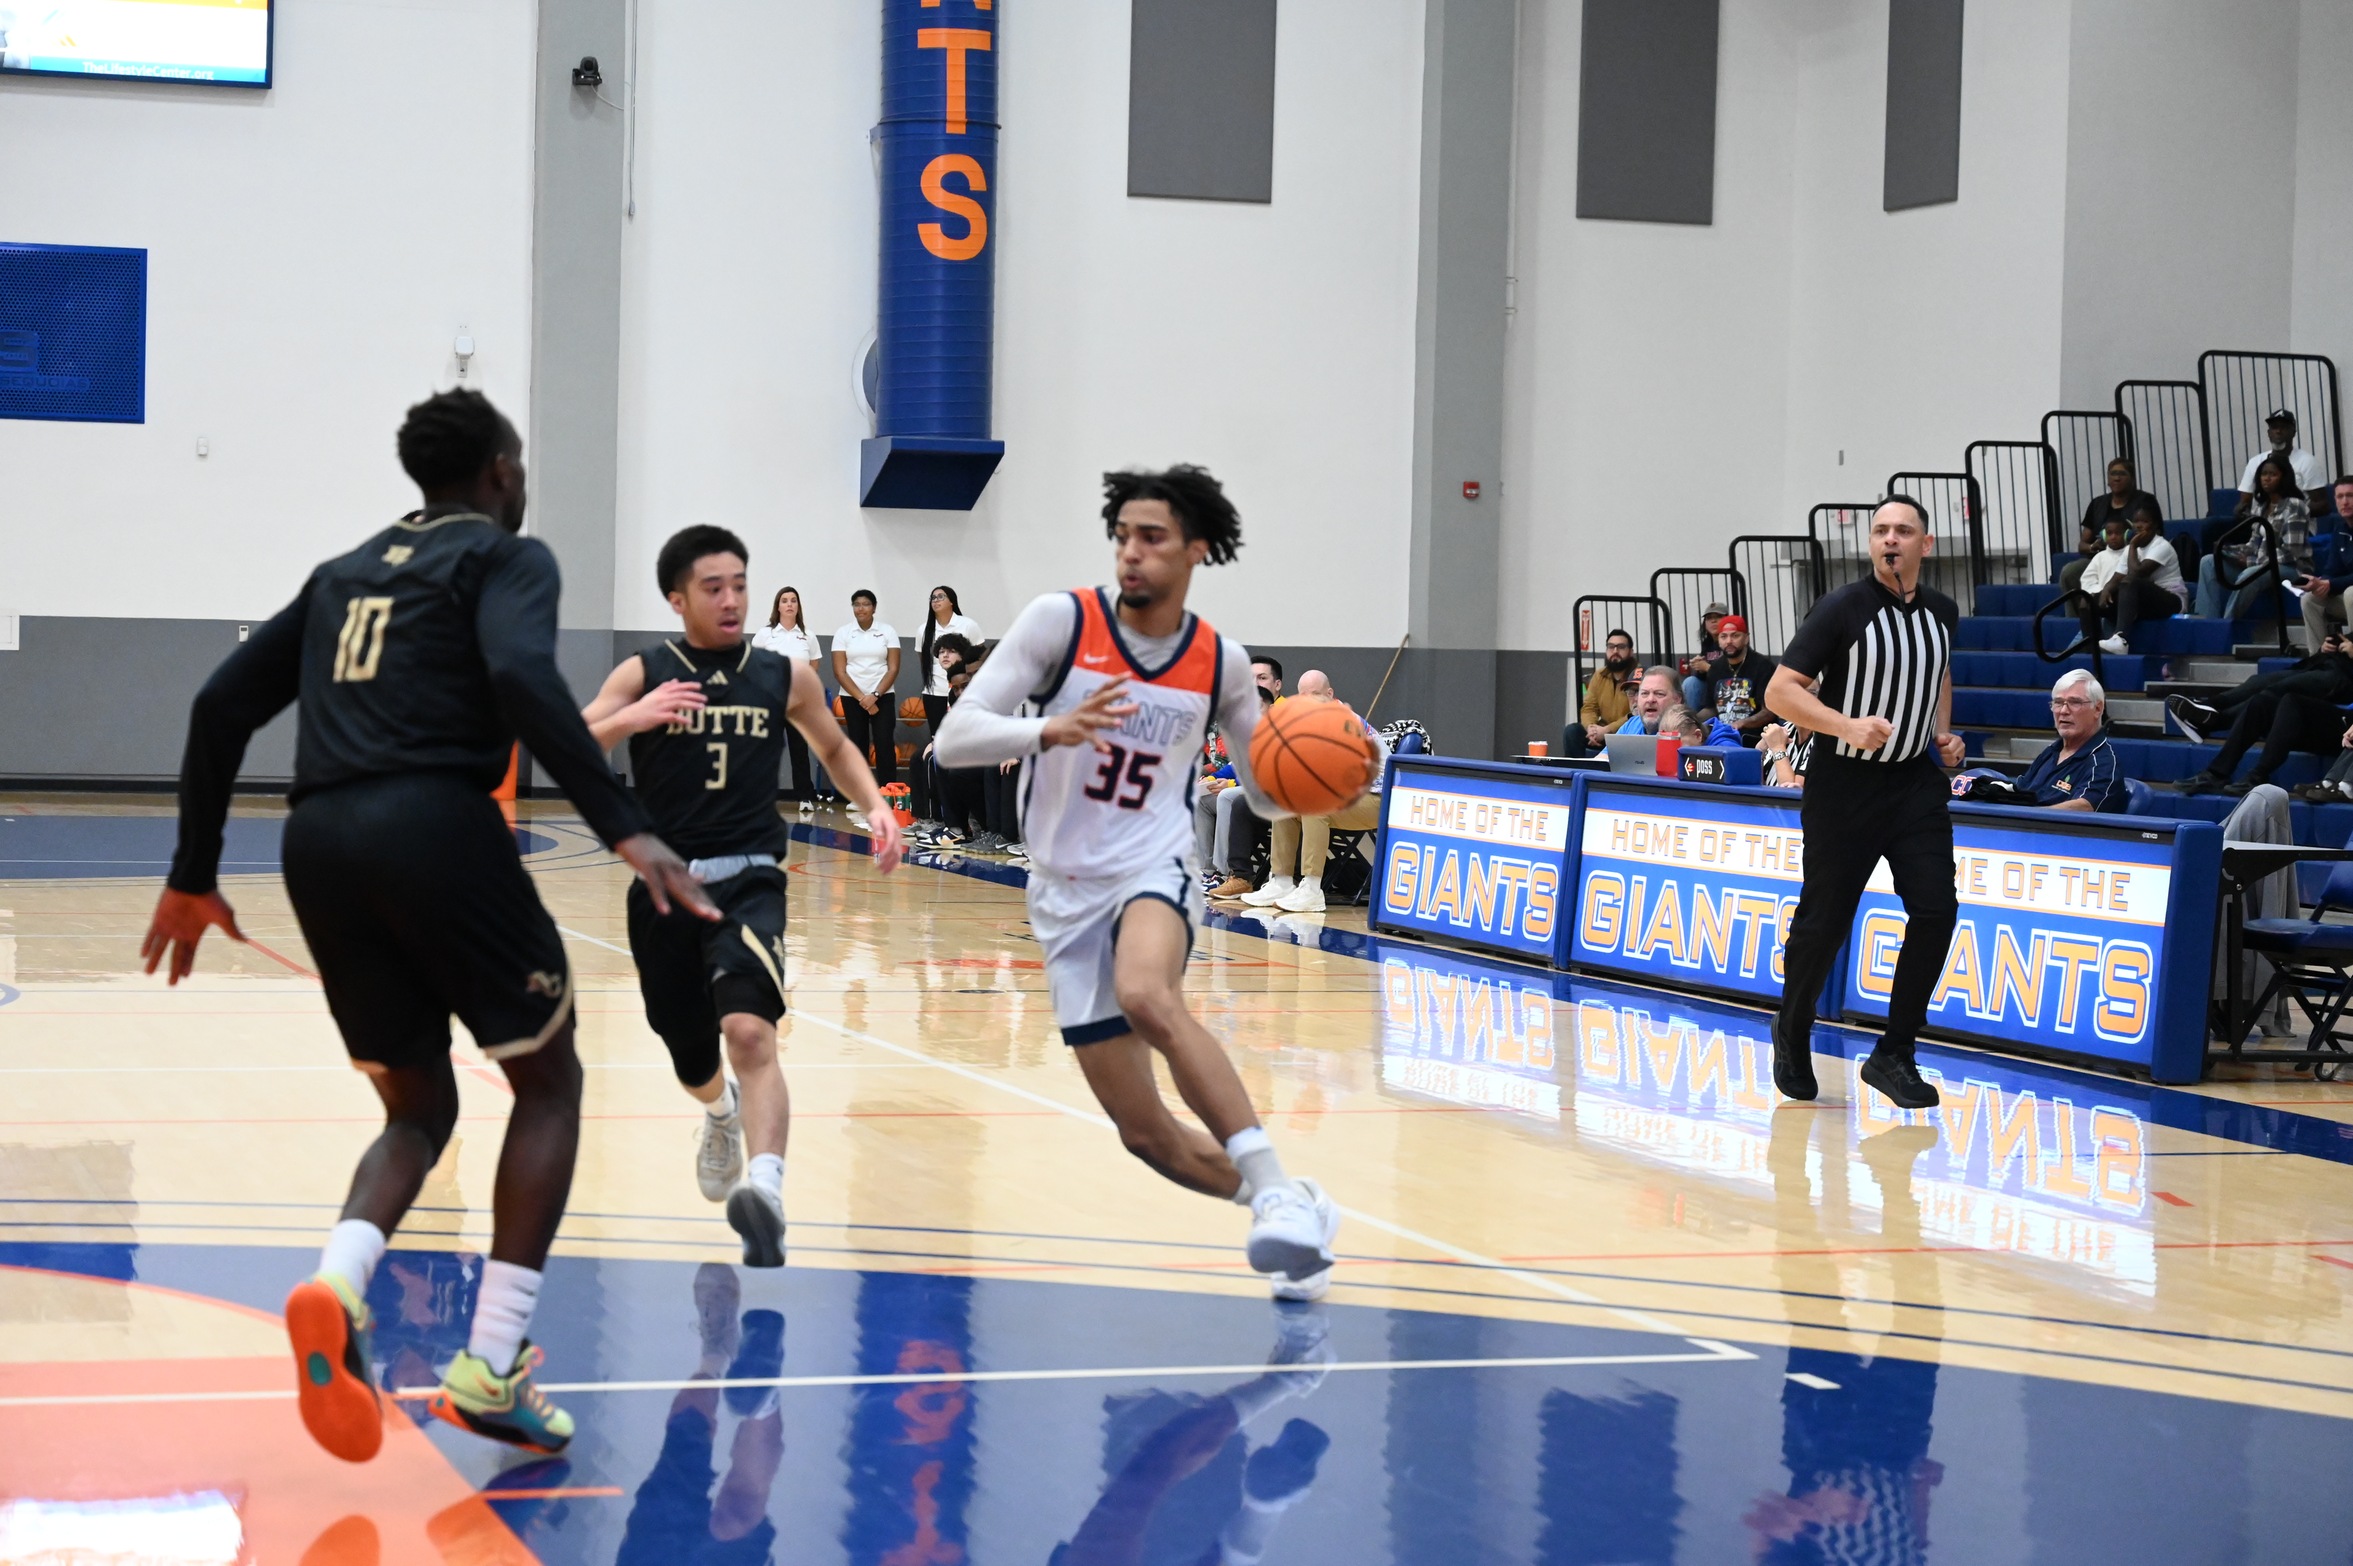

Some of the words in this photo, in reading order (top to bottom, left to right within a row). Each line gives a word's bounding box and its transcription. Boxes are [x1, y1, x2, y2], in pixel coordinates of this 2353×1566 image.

[82, 61, 214, 80] TheLifestyleCenter.org
[918, 0, 992, 261] TS
[332, 596, 395, 682] 10
[705, 742, 728, 789] 3
[1084, 742, 1162, 810] 35
[1410, 796, 1467, 831] HOME
[1475, 804, 1502, 834] OF
[1508, 808, 1548, 841] THE
[1612, 819, 1688, 859] HOME
[1700, 829, 1736, 863] OF
[1745, 833, 1801, 872] THE
[1386, 841, 1559, 942] GIANTS
[2003, 861, 2048, 900] OF
[2060, 867, 2130, 911] THE
[1856, 908, 2153, 1044] GANTS
